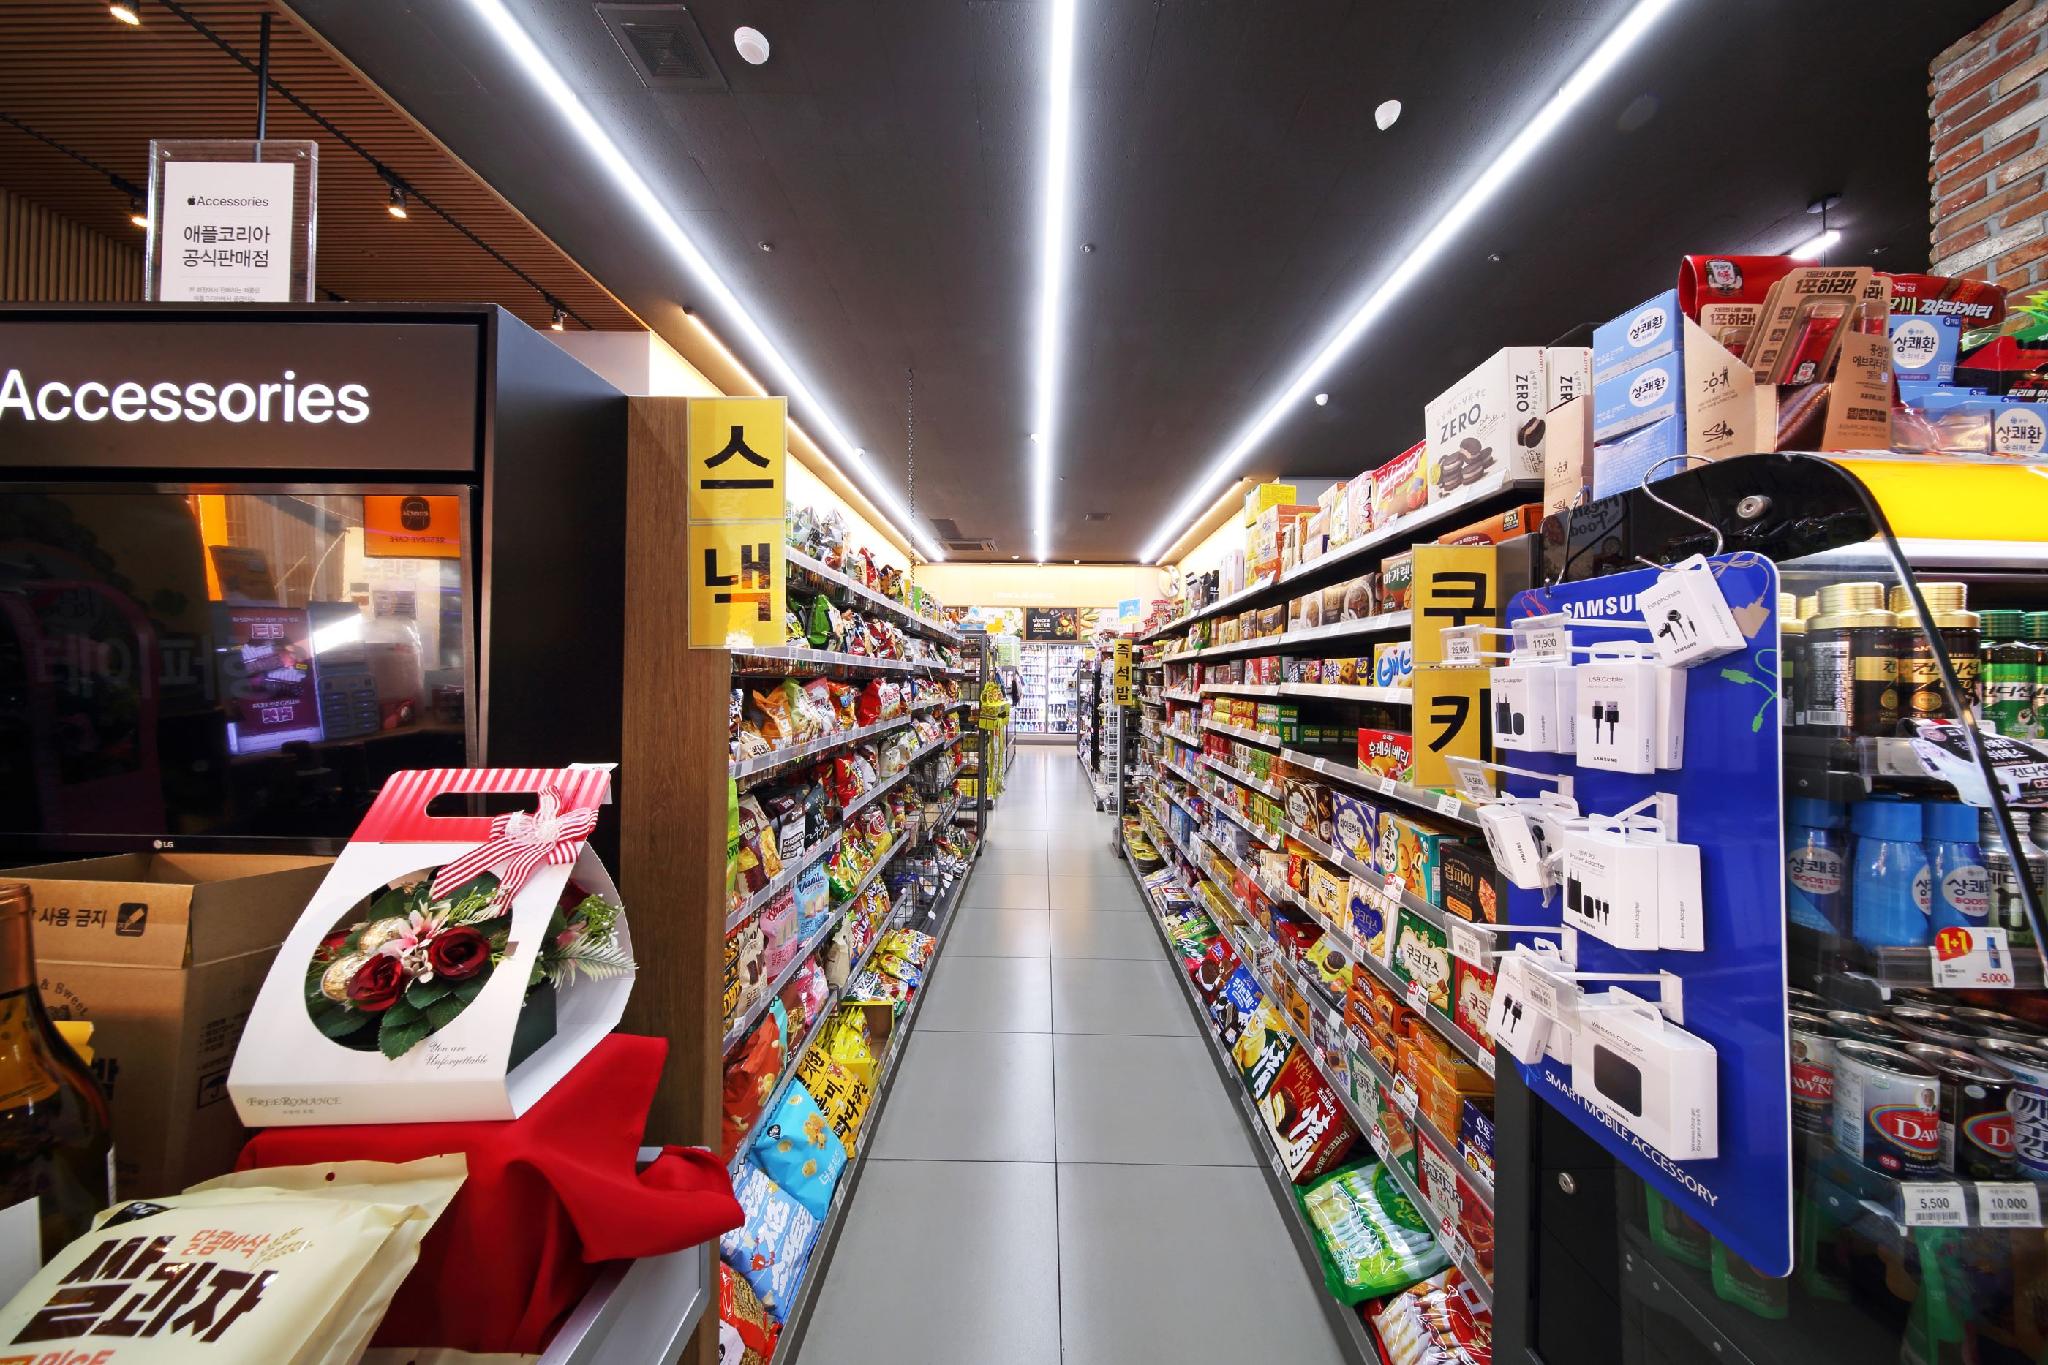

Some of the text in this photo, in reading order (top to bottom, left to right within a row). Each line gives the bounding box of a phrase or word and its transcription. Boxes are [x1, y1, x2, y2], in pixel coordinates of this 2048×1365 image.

[196, 197, 269, 207] Accessories
[184, 226, 270, 244] 애플코리아
[182, 249, 269, 268] 공식판매점
[1795, 278, 1858, 294] 1포하라!
[1629, 314, 1664, 340] 상쾌환
[1710, 313, 1756, 326] 1포하라!
[1894, 335, 1936, 353] 상쾌환
[0, 368, 371, 424] Accessories
[1515, 374, 1530, 413] ZERO
[1560, 376, 1573, 402] ZER
[1631, 375, 1667, 399] 상쾌환
[1440, 403, 1482, 445] ZERO
[1995, 425, 2042, 444] 상쾌환
[700, 425, 775, 622] 스낵
[1647, 589, 1681, 610] Earphones
[1116, 643, 1130, 701] 즉석밥
[1423, 571, 1497, 763] 쿠키
[1368, 741, 1410, 766] 후레쉬베리
[1946, 877, 1991, 897] 상쾌
[39, 907, 108, 929] 사용 금지
[1939, 932, 1969, 955] 1+1
[1405, 941, 1441, 979] 쿠크다스
[1981, 973, 2009, 985] 5,000
[1470, 990, 1491, 1016] 쿠크
[425, 1052, 488, 1070] Unforgettable
[1545, 1069, 1719, 1208] SMART MOBILE ACCESSORY
[1897, 1118, 1938, 1142] DAW
[1920, 1197, 1950, 1210] 5,500
[181, 1228, 270, 1258] 달콤바삭
[10, 1235, 279, 1345] 쌀과자
